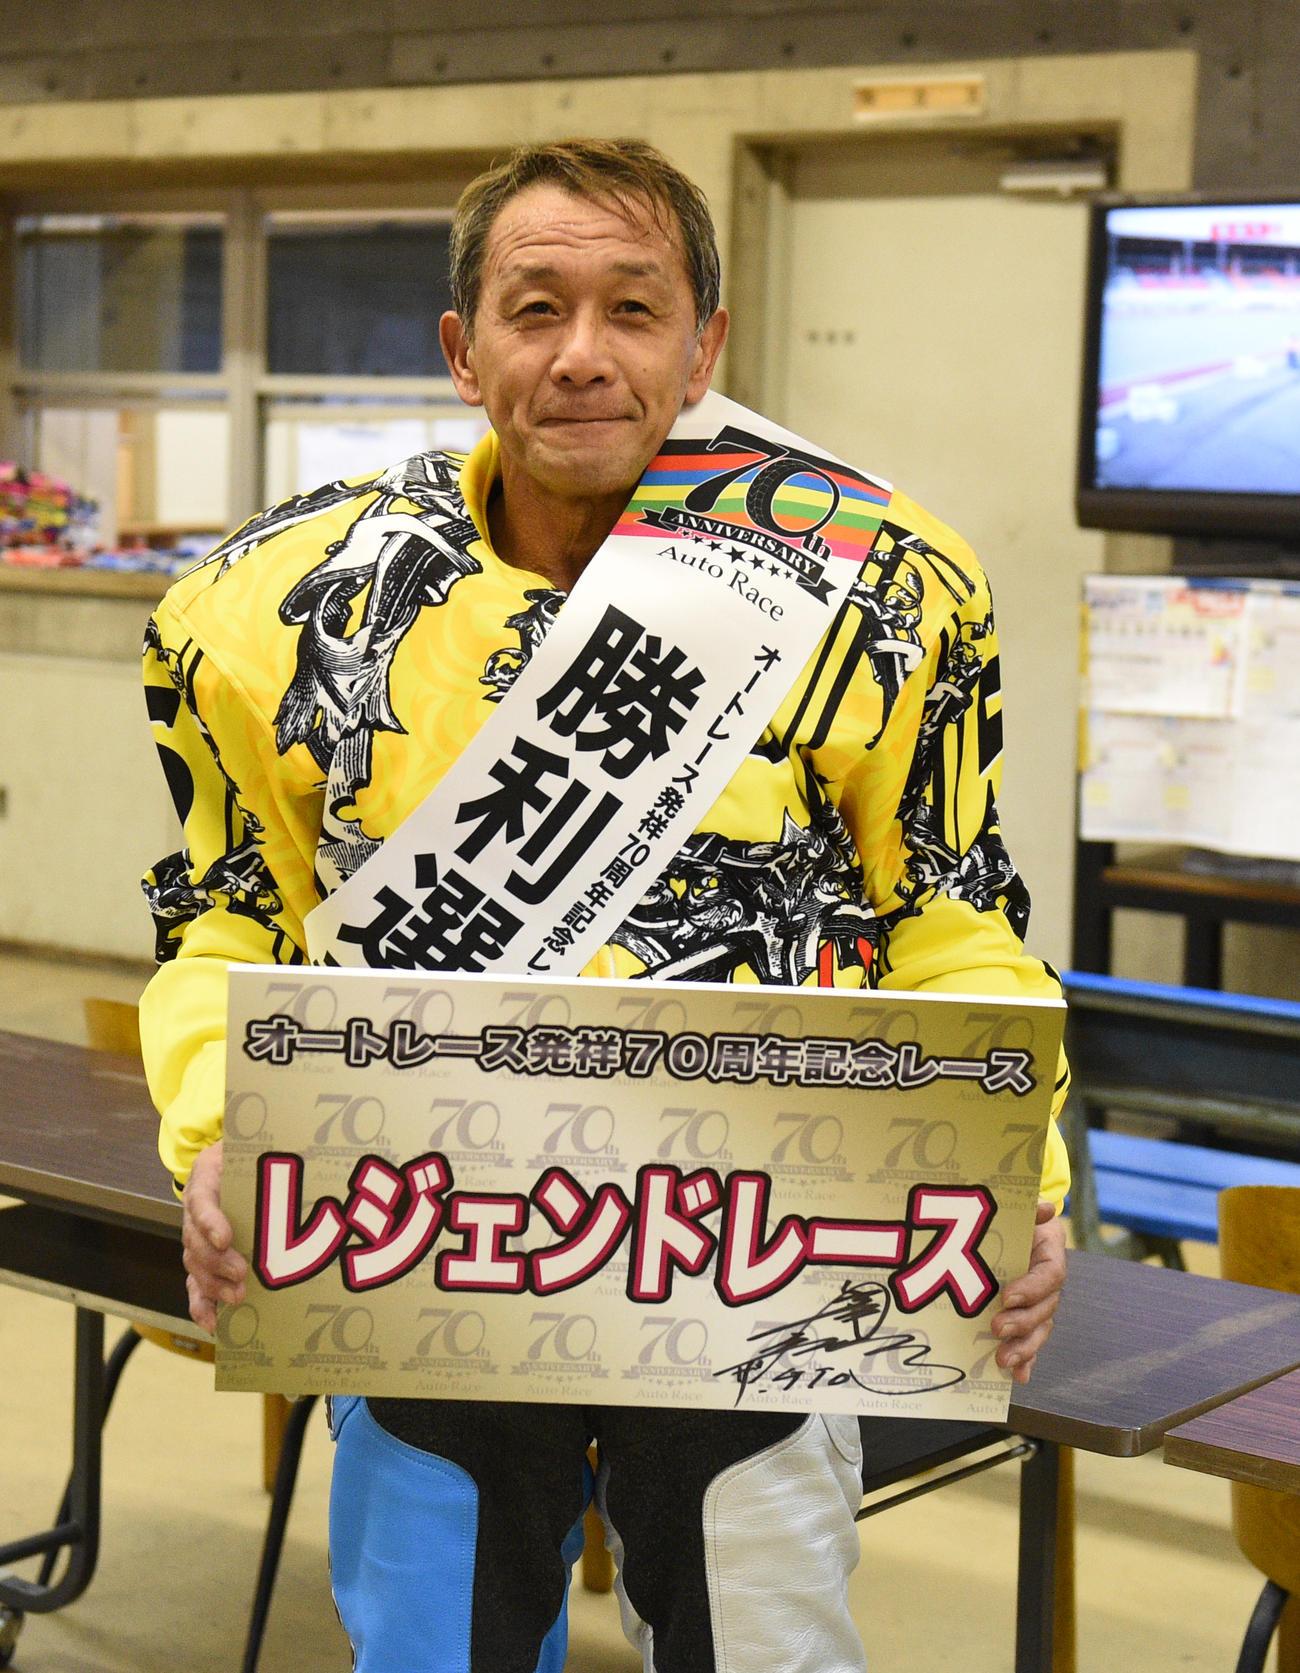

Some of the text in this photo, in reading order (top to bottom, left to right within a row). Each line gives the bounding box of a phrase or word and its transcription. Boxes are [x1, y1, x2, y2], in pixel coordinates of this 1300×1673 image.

[657, 546, 784, 621] Auto Race
[671, 513, 816, 576] ANNIVERSARY
[313, 603, 707, 972] 勝利選
[527, 644, 781, 975] オートレース発祥70周年記念レ
[246, 1014, 1036, 1096] オートレース発祥70周年記念レース
[253, 1152, 998, 1318] レジェンドレース
